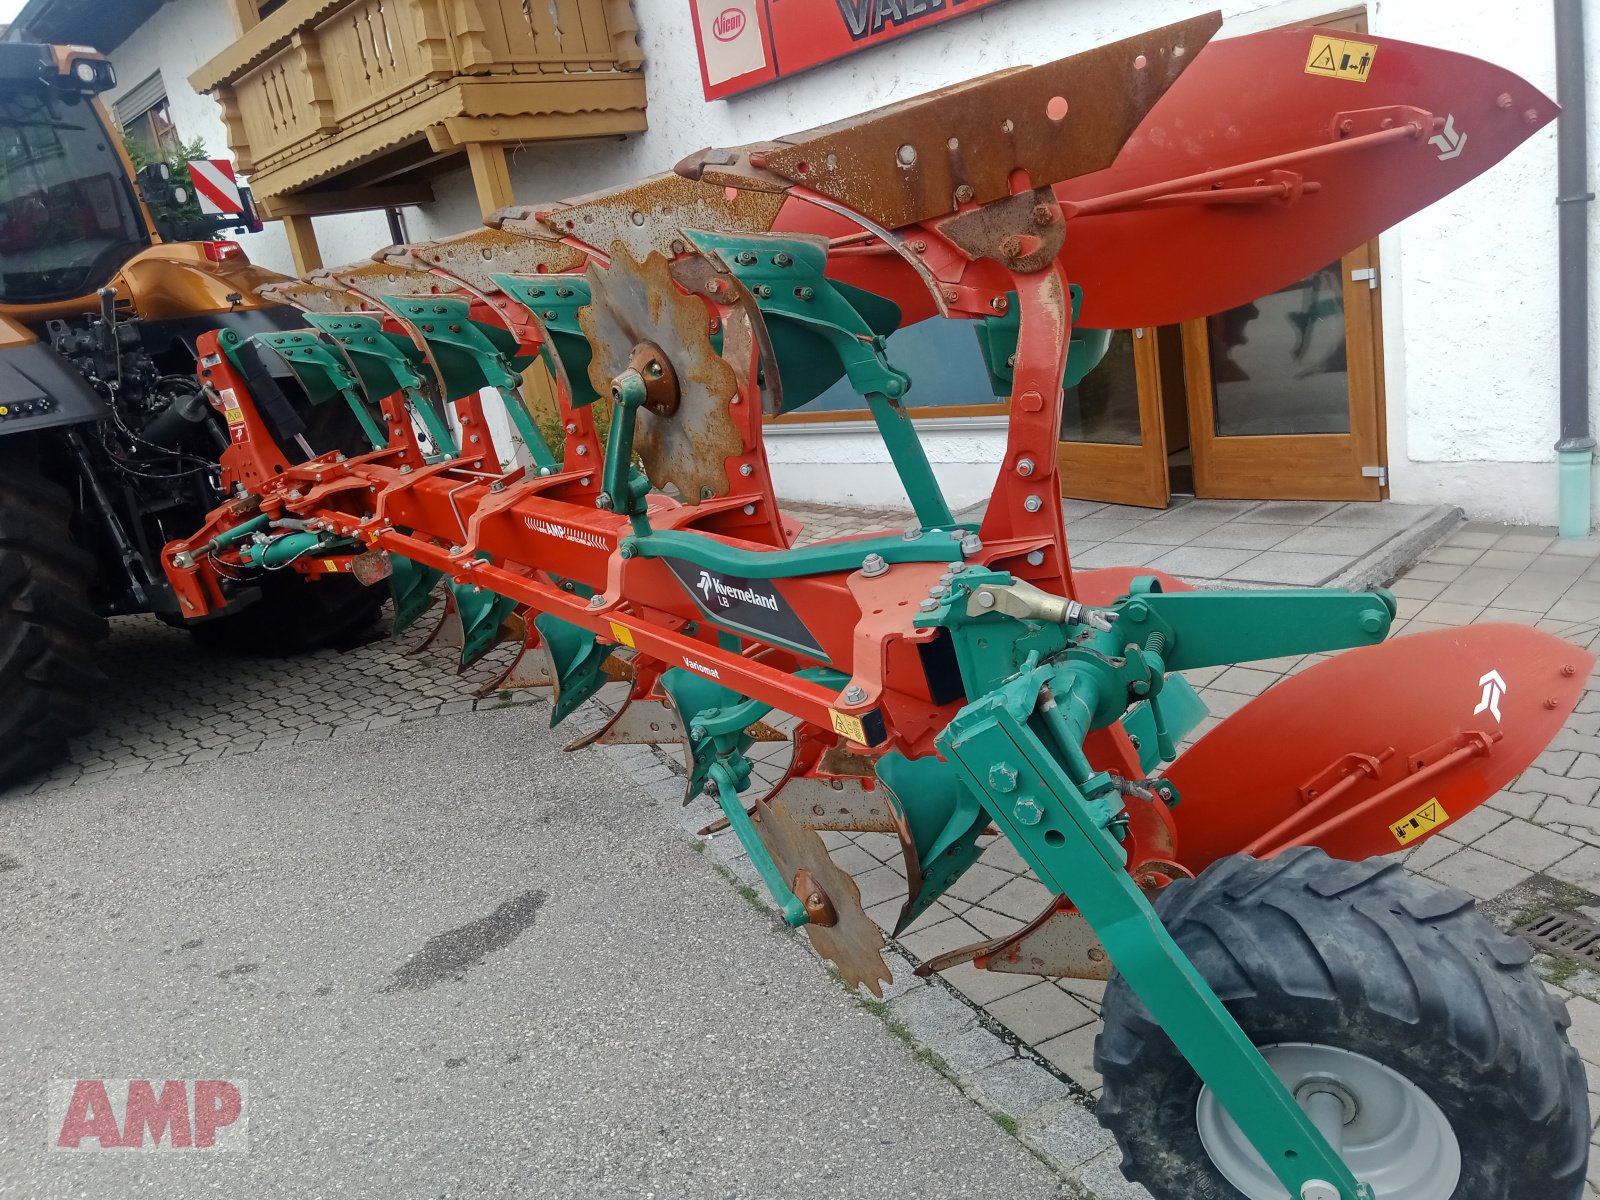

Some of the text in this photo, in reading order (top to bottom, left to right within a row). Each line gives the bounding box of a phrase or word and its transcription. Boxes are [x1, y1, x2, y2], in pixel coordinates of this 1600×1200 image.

[714, 13, 741, 35] Vicon
[545, 522, 565, 539] AMP
[711, 577, 779, 611] Kverneland
[682, 655, 720, 680] Variomat
